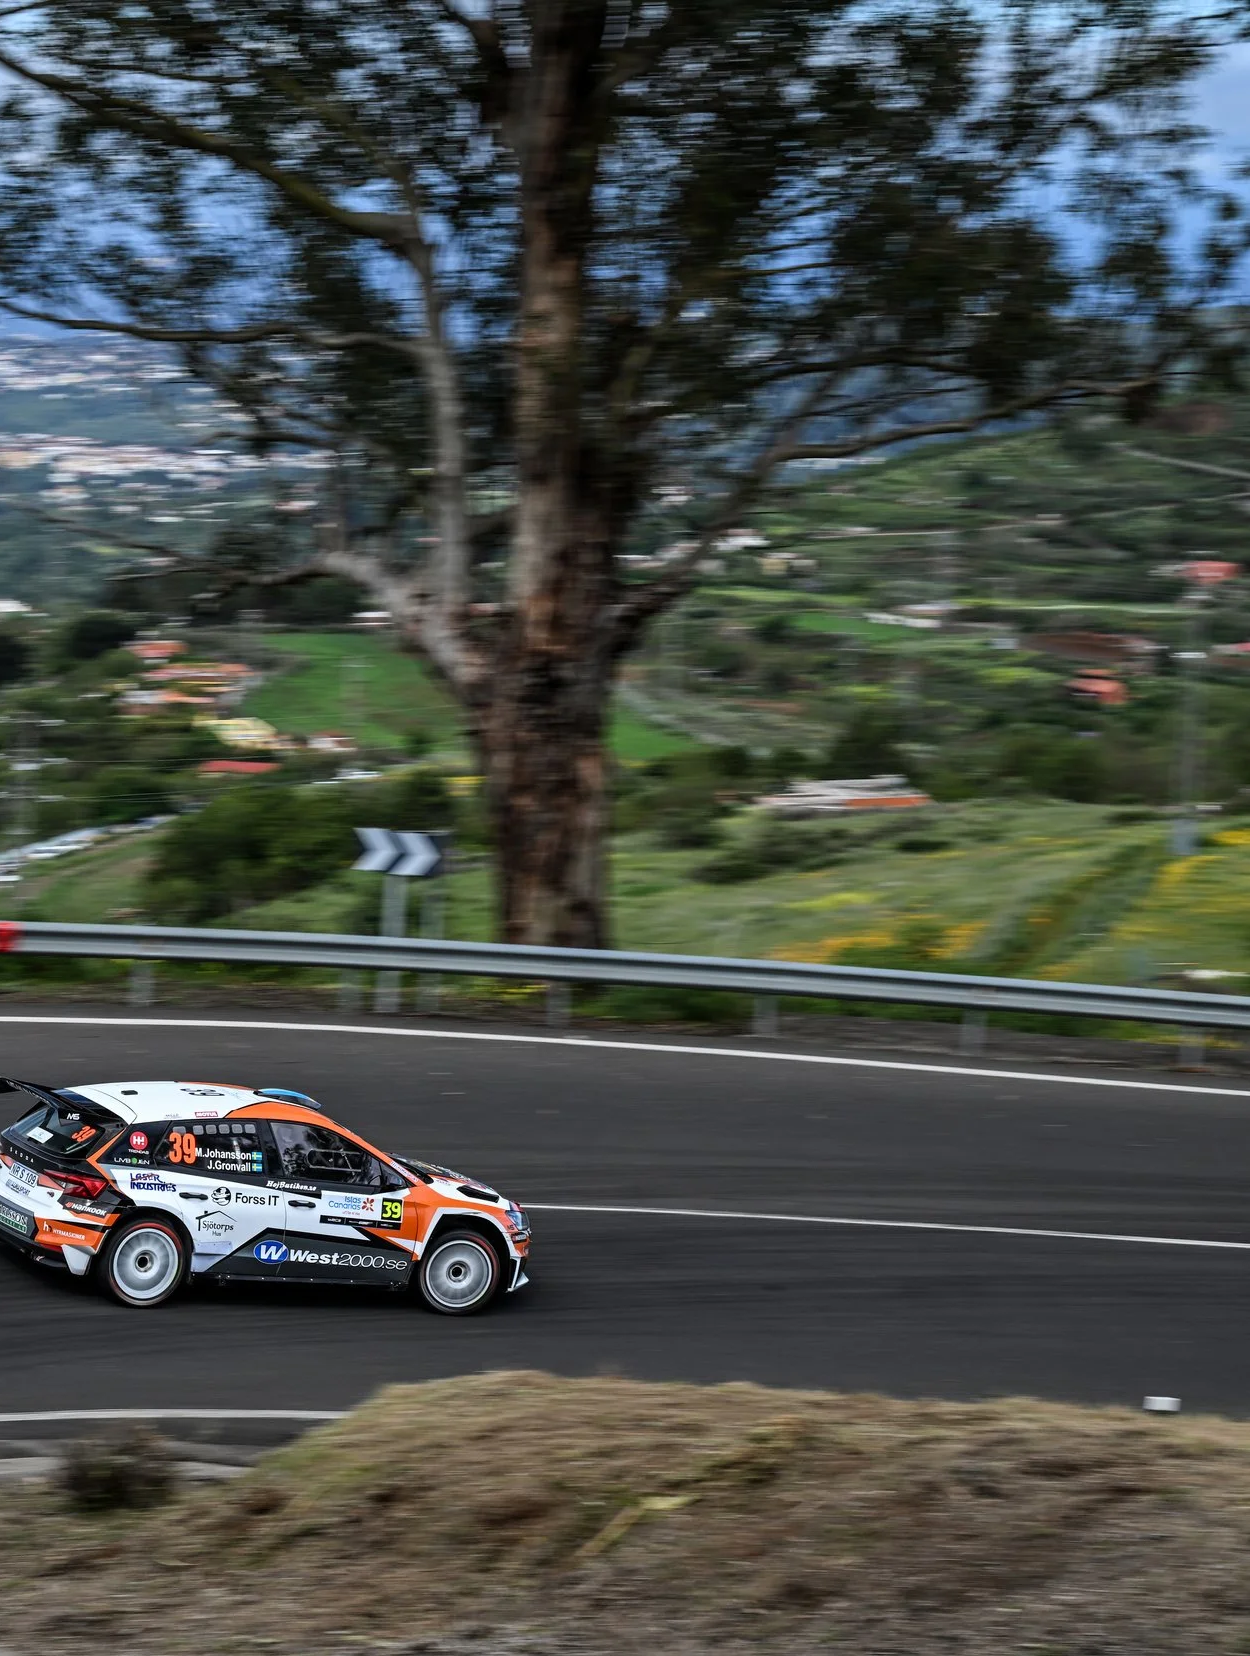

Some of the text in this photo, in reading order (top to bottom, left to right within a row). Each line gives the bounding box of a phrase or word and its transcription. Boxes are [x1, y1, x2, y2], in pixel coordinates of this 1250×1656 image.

[72, 1125, 96, 1142] 39
[168, 1132, 197, 1165] 39
[195, 1147, 252, 1161] M.Johansson
[207, 1160, 251, 1172] J.Gronvall
[235, 1192, 279, 1206] Forss IT
[328, 1200, 361, 1211] Canarias
[344, 1196, 362, 1204] Islas
[382, 1201, 402, 1219] 39
[202, 1220, 234, 1233] Sjötorps
[260, 1245, 408, 1271] W West2000.se
